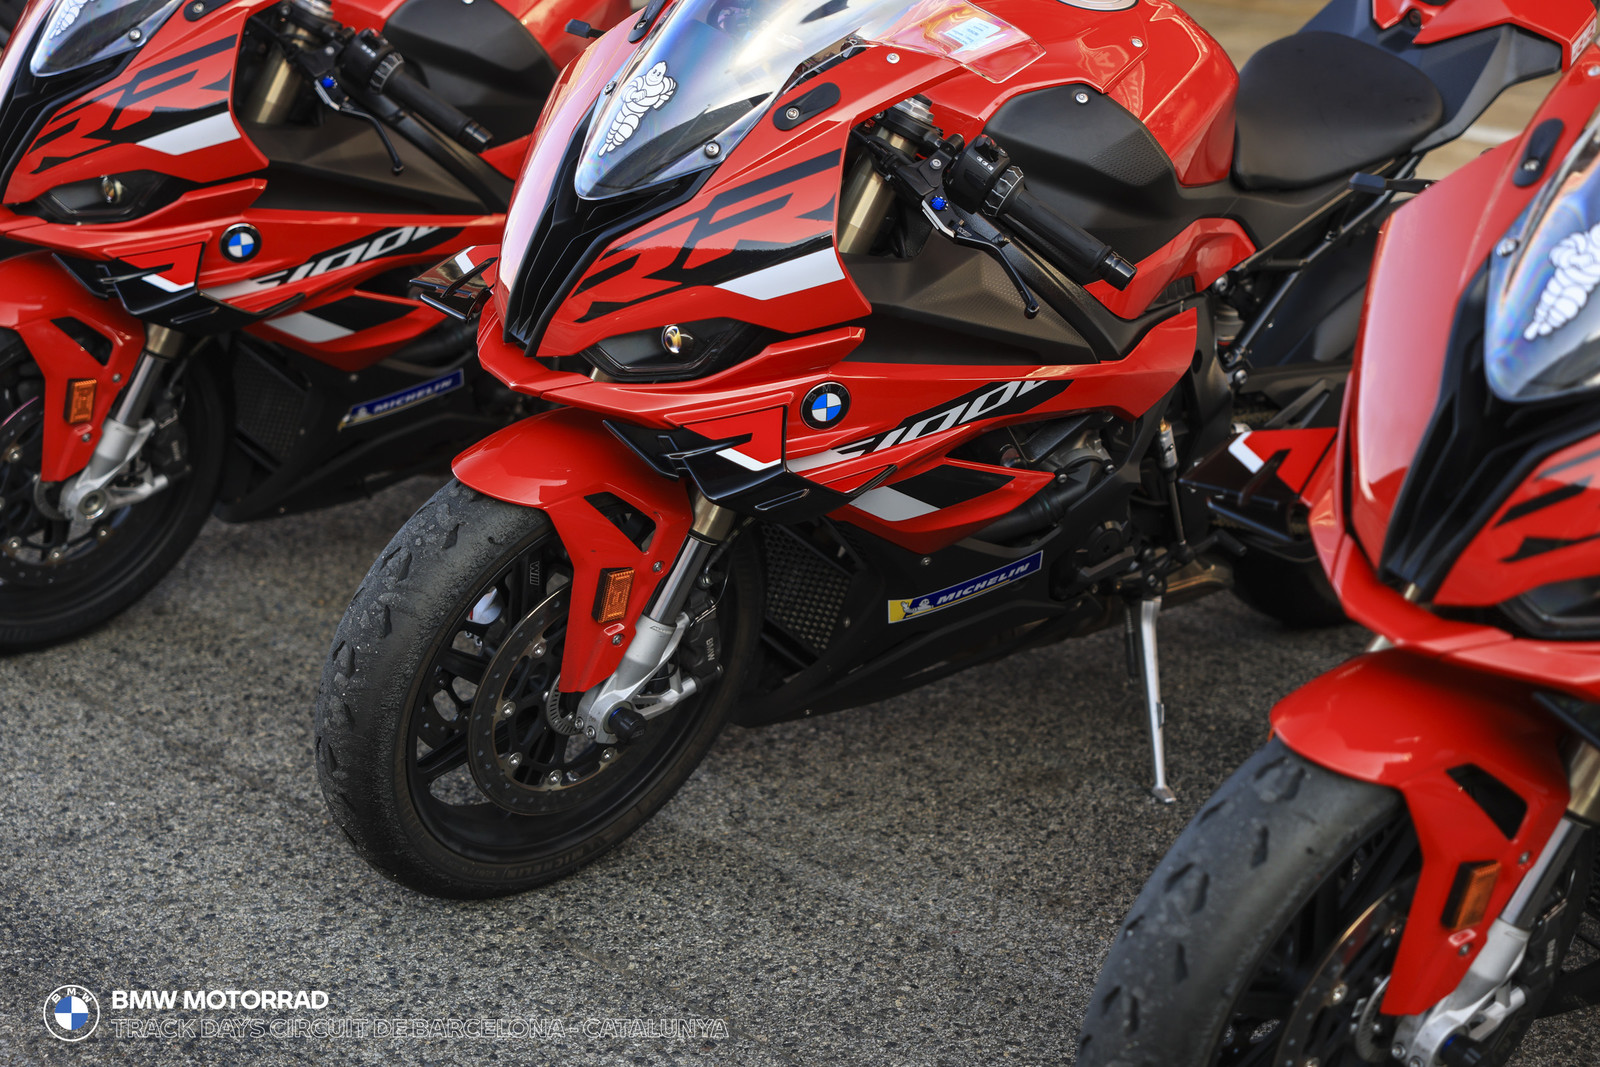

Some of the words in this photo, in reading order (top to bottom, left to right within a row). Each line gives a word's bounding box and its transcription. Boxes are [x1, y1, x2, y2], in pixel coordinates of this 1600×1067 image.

[372, 378, 453, 414] MICHELIN
[936, 562, 1030, 606] MICHELIN
[705, 637, 715, 661] BMW
